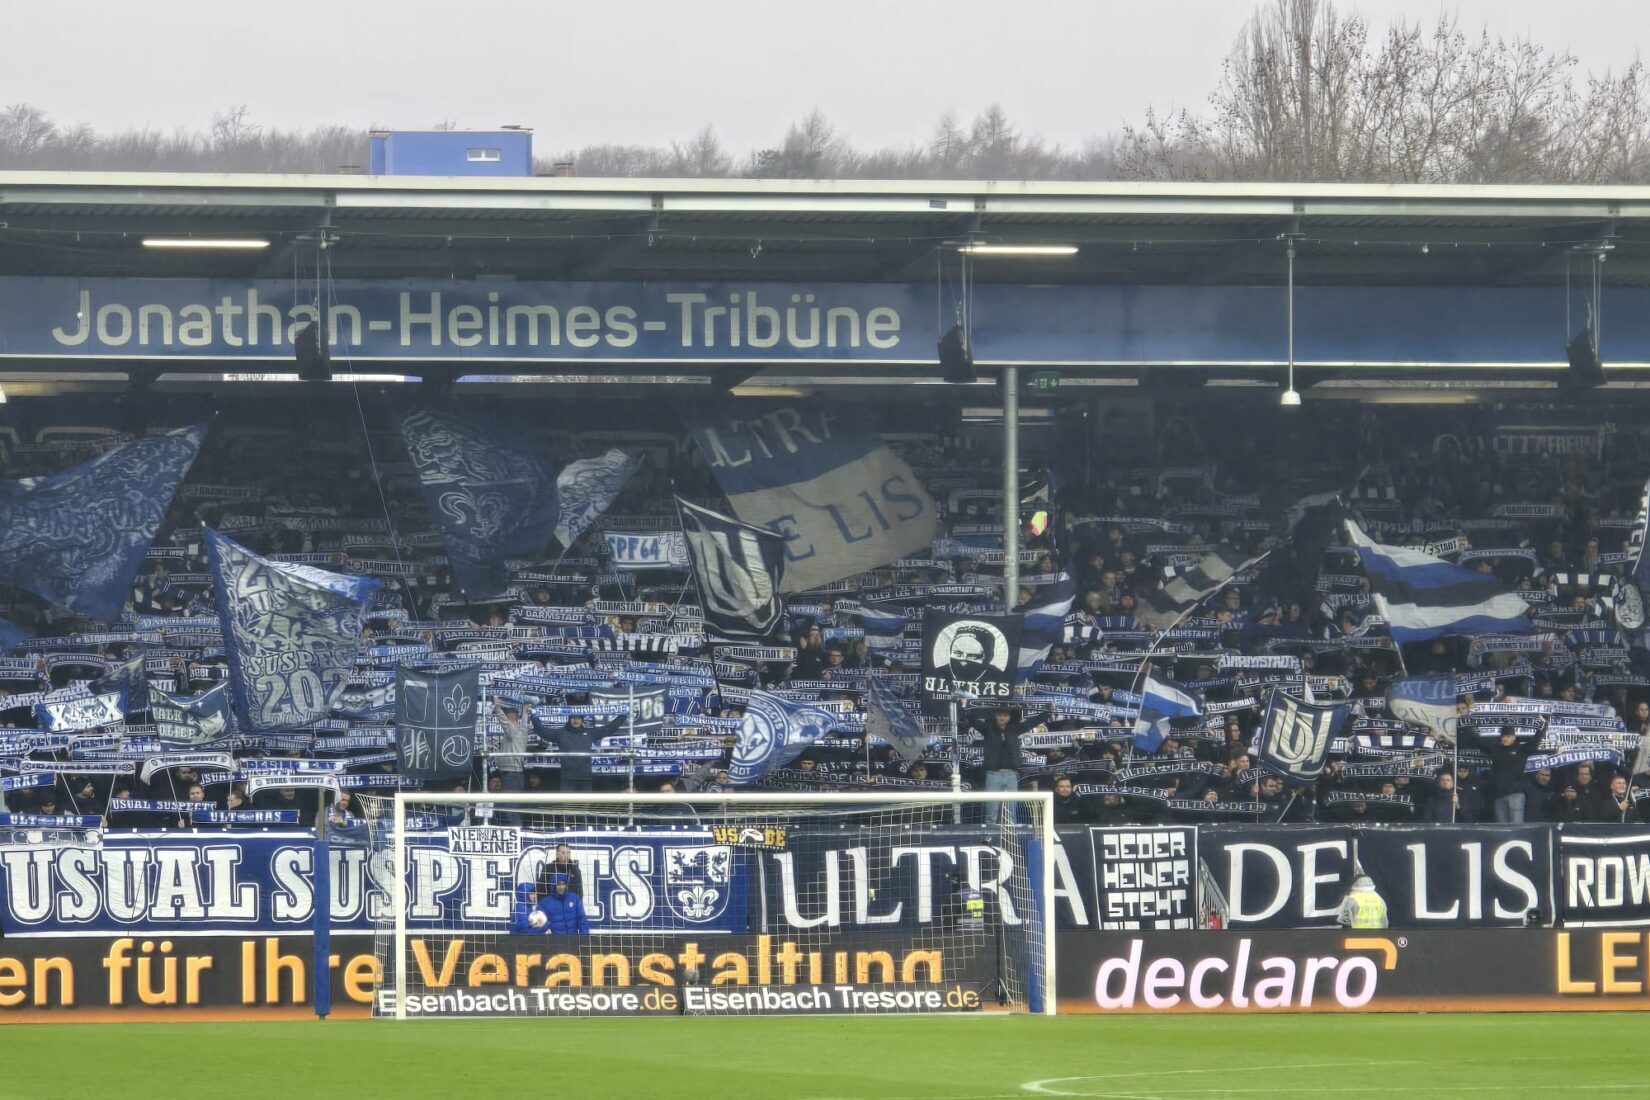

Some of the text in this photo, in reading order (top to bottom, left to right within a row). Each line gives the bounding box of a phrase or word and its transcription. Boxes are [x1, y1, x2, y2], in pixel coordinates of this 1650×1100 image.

[52, 289, 901, 348] Jonathan-Heimes-Tribüne
[598, 601, 645, 612] DARMSTADT
[525, 610, 584, 621] DARMSTADT
[445, 630, 504, 638] DARMSTADT
[525, 644, 584, 654] DARMSTADT
[732, 647, 781, 659] DARMSTADT
[497, 681, 560, 693] DARMSTADT
[925, 677, 1010, 696] ULTRAS
[1564, 718, 1618, 728] DARMSTADT
[1033, 734, 1083, 747] DARMSTA
[1122, 766, 1158, 780] ULTRA
[1171, 763, 1188, 772] DE
[1191, 762, 1208, 771] LIS
[1078, 783, 1118, 793] ULTRA
[1132, 786, 1150, 795] DE
[112, 799, 150, 810] USUAL
[1176, 799, 1247, 811] ULTRA DE
[451, 829, 518, 841] NIEMALS
[452, 841, 518, 853] ALLEINE!
[1103, 832, 1185, 859] JEDER
[1104, 860, 1189, 889] HEINER
[1223, 840, 1348, 922] DE
[1406, 839, 1539, 920] LIS
[4, 847, 258, 923] USUAL
[1108, 889, 1186, 917] STEHT
[1557, 932, 1650, 994] LE
[0, 956, 73, 1005] en
[103, 939, 213, 1005] für
[1094, 938, 1378, 1009] declaro
[378, 987, 677, 1012] Esenbach Tresore.de
[683, 984, 979, 1010] Eisenbach Tresore.de
